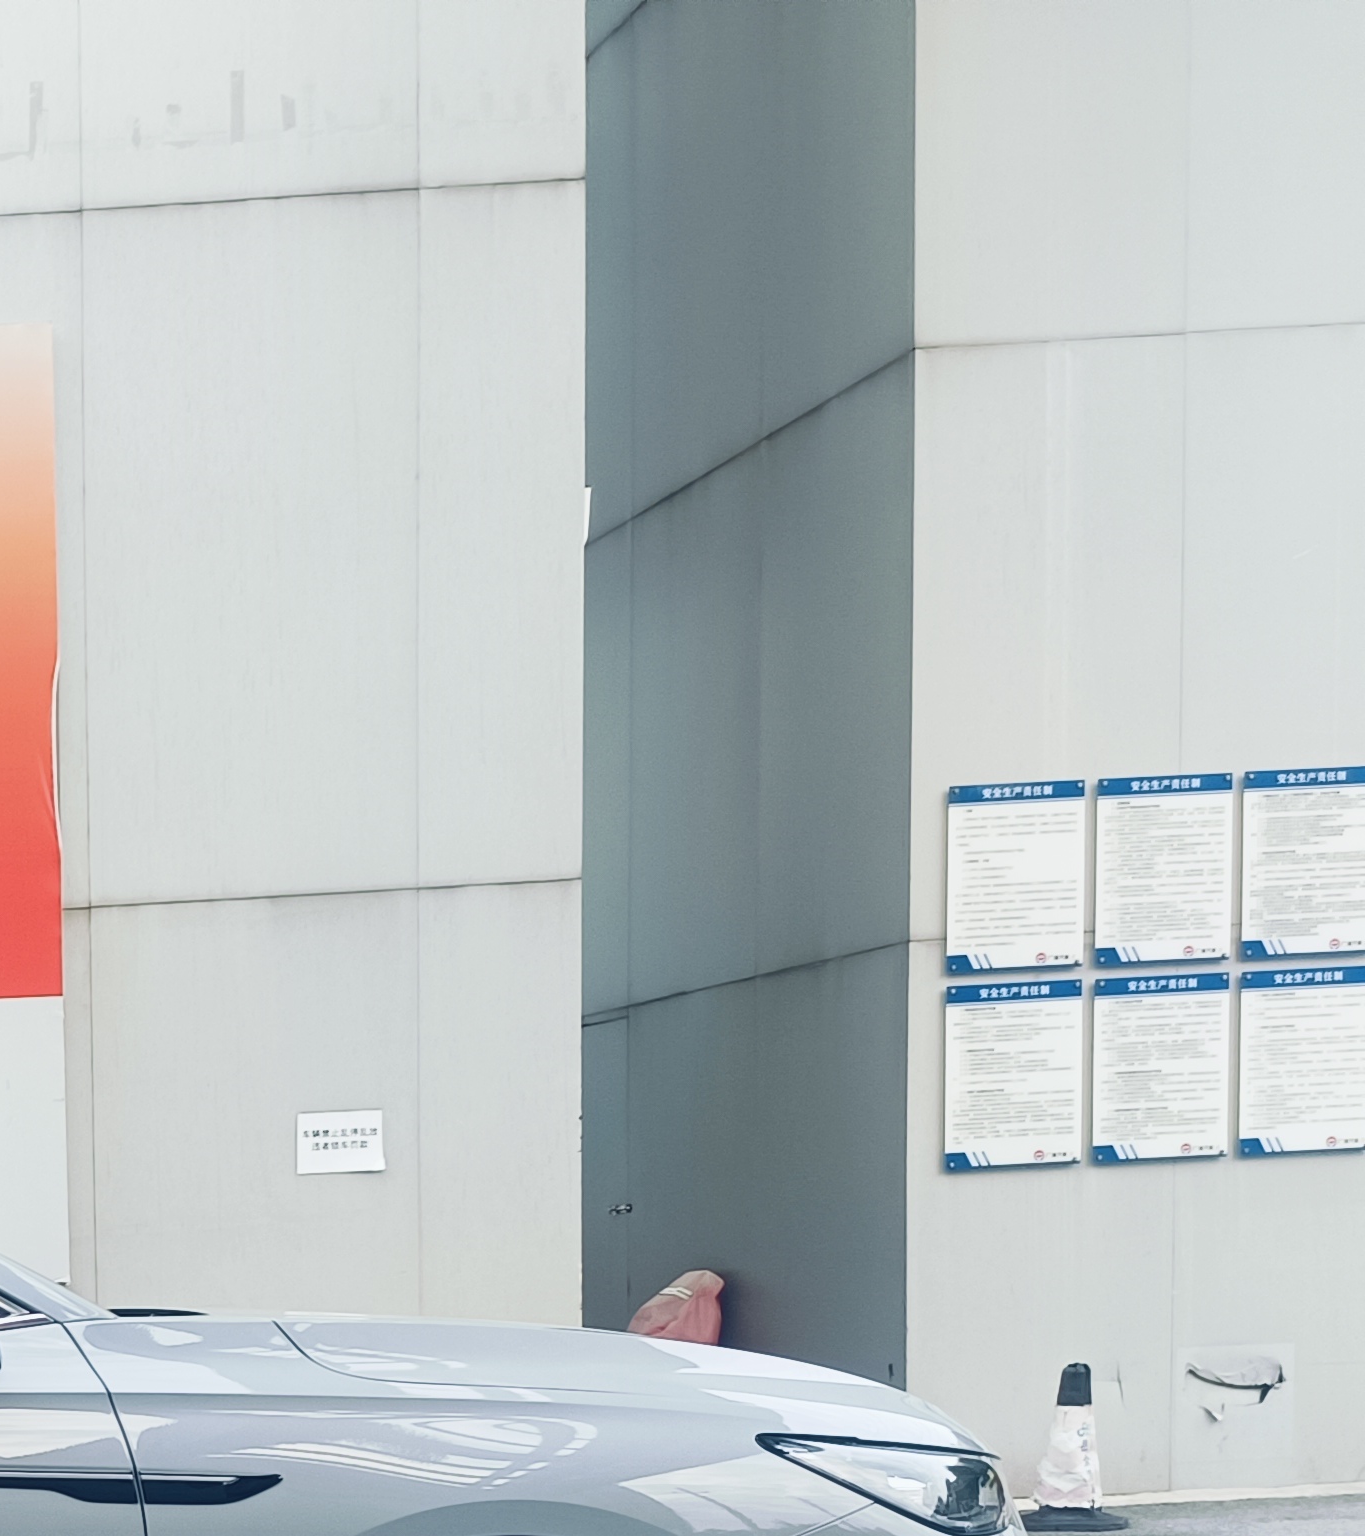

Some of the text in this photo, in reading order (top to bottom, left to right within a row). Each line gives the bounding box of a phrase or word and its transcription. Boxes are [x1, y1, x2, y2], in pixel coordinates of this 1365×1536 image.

[981, 784, 1054, 800] 安全生产责任制
[1130, 777, 1202, 793] 安全生产责任制
[978, 983, 1051, 999] 安全生产责任制
[1127, 976, 1199, 993] 安全生产责任制
